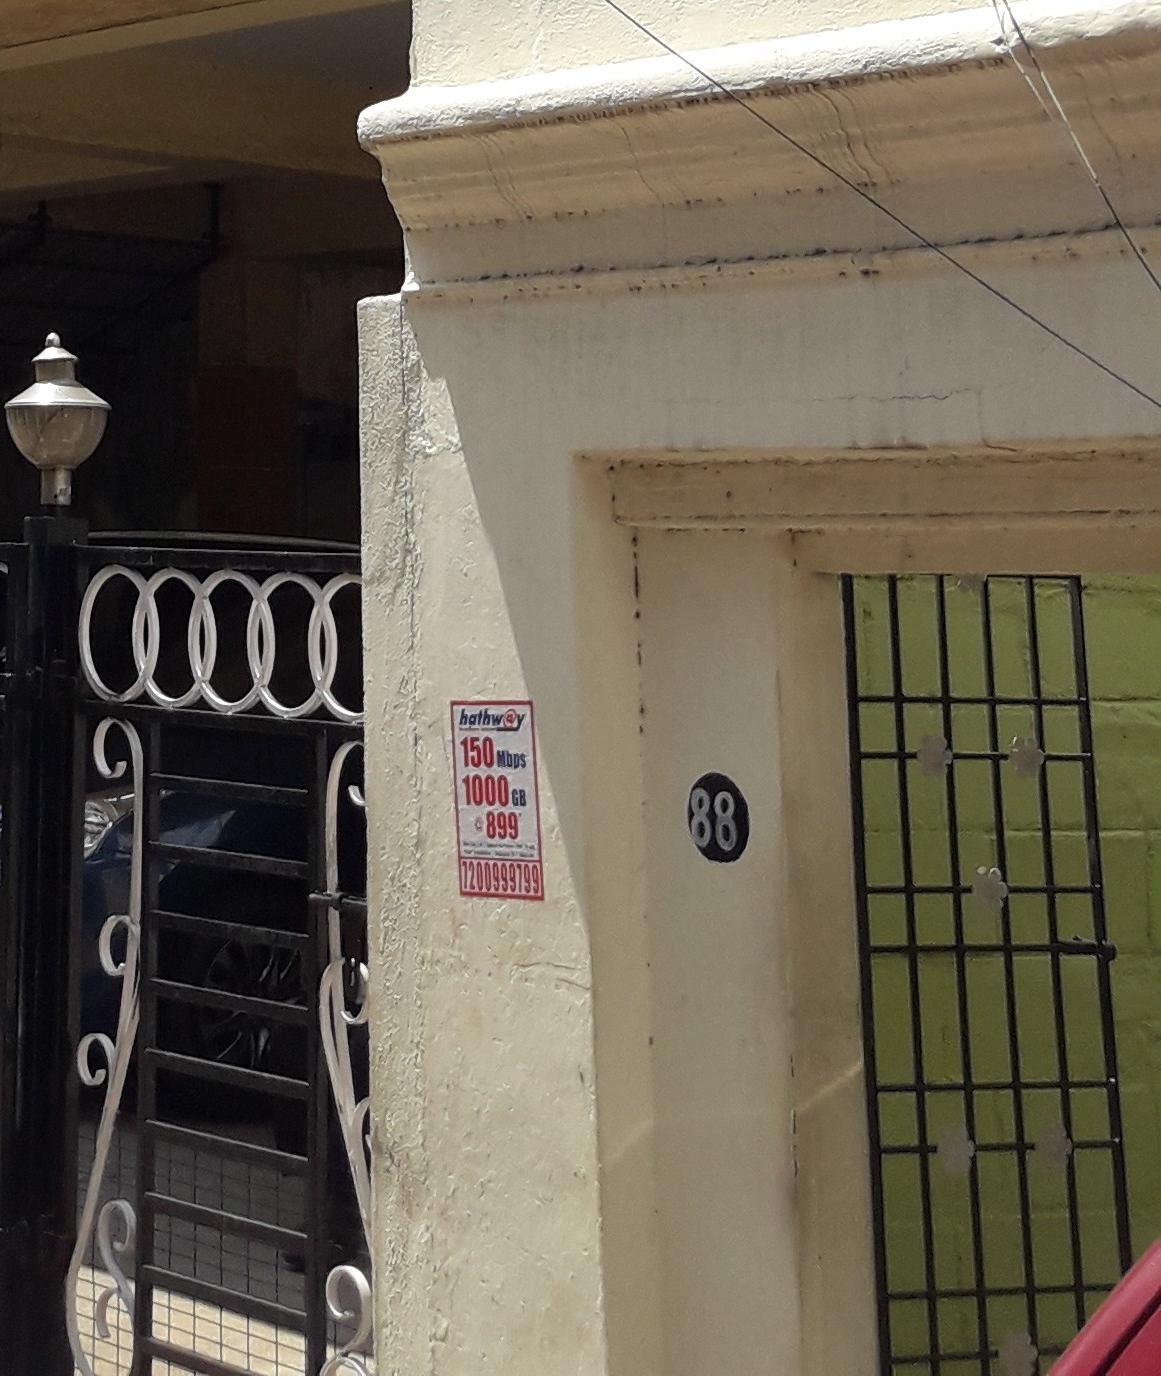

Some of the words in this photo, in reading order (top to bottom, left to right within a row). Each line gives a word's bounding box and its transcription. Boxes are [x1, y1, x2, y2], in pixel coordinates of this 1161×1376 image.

[460, 736, 495, 768] 150
[497, 750, 527, 769] Mbps
[462, 774, 509, 807] 1000
[512, 788, 527, 807] GB
[691, 787, 737, 851] 88
[462, 860, 539, 894] 7200999799
